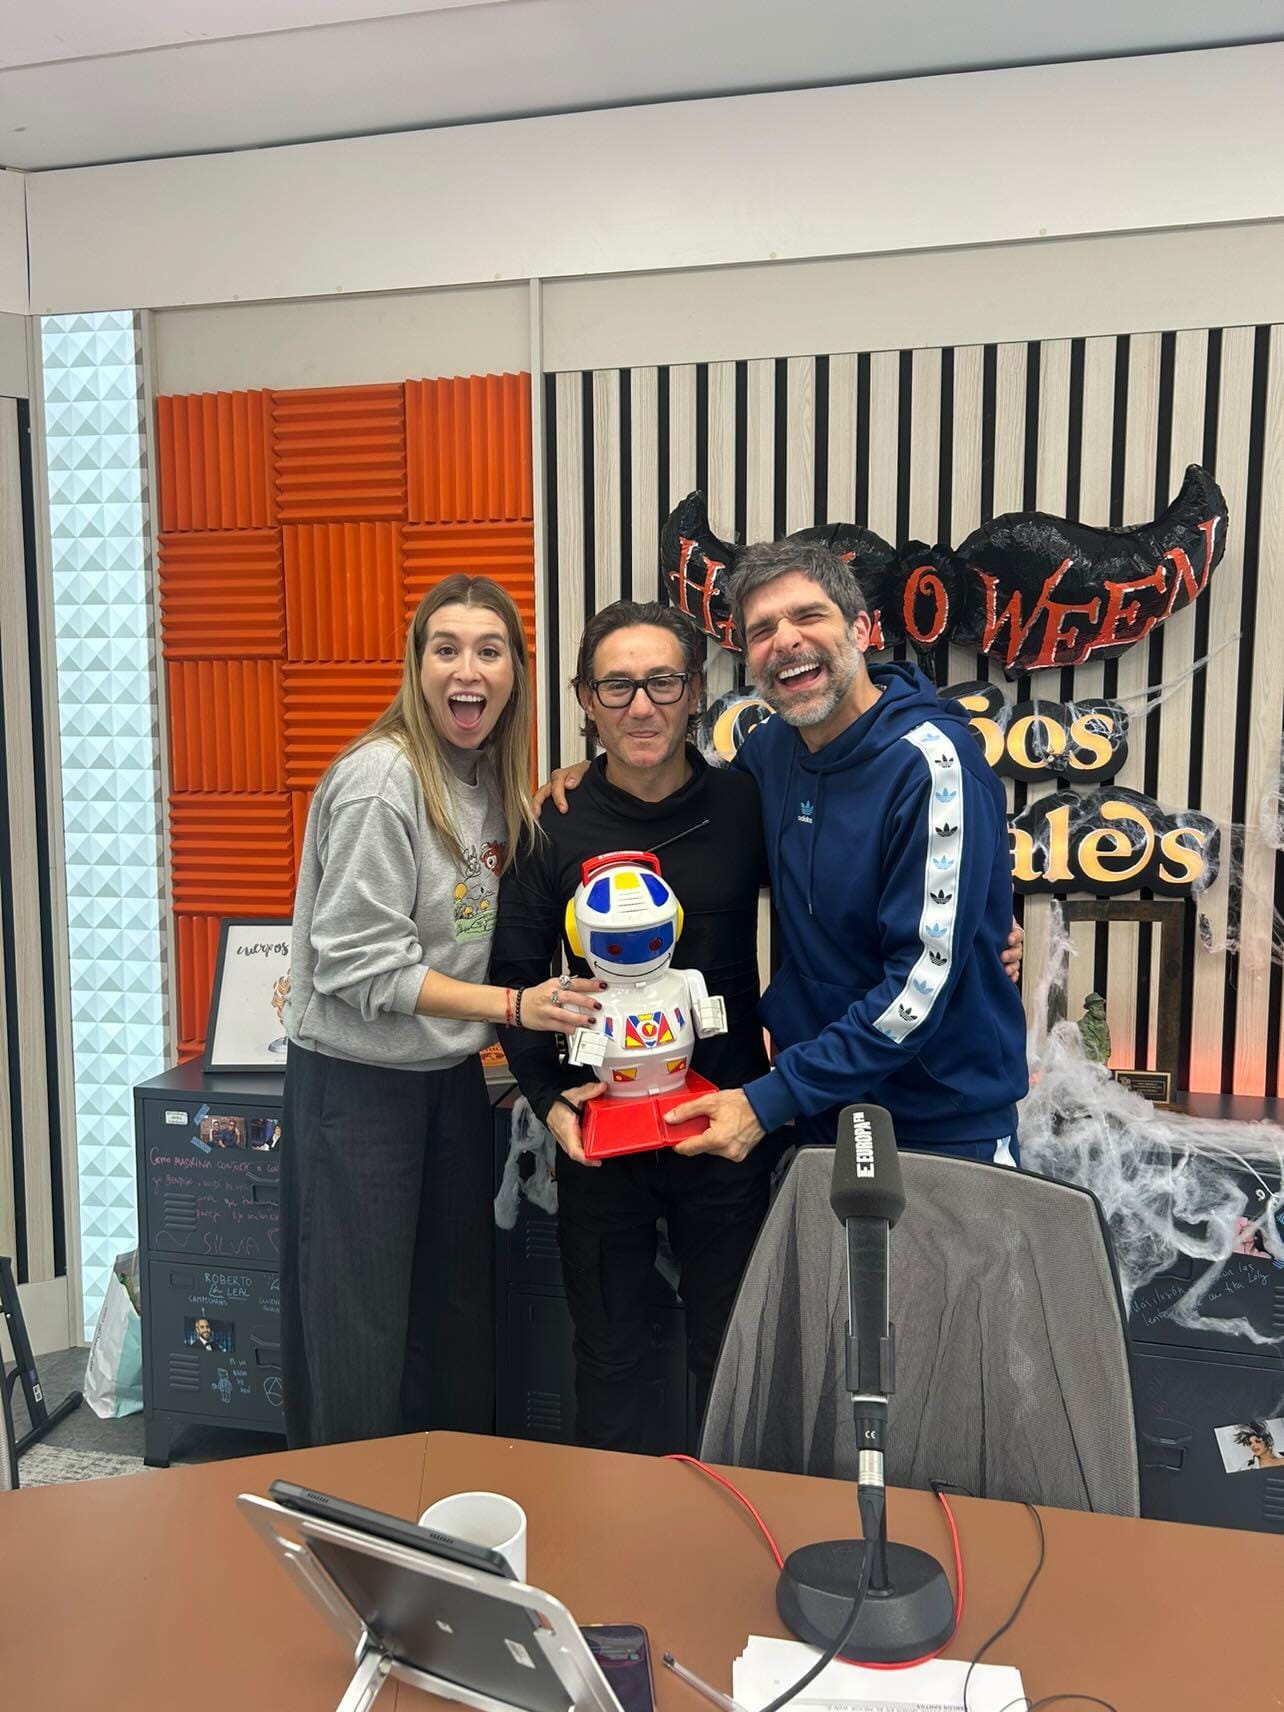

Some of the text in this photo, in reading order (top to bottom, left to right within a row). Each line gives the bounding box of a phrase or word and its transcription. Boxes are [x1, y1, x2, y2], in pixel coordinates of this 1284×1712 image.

[853, 1121, 875, 1163] EUROPA
[204, 1272, 253, 1288] ROBERTO
[226, 1287, 251, 1297] LEAL
